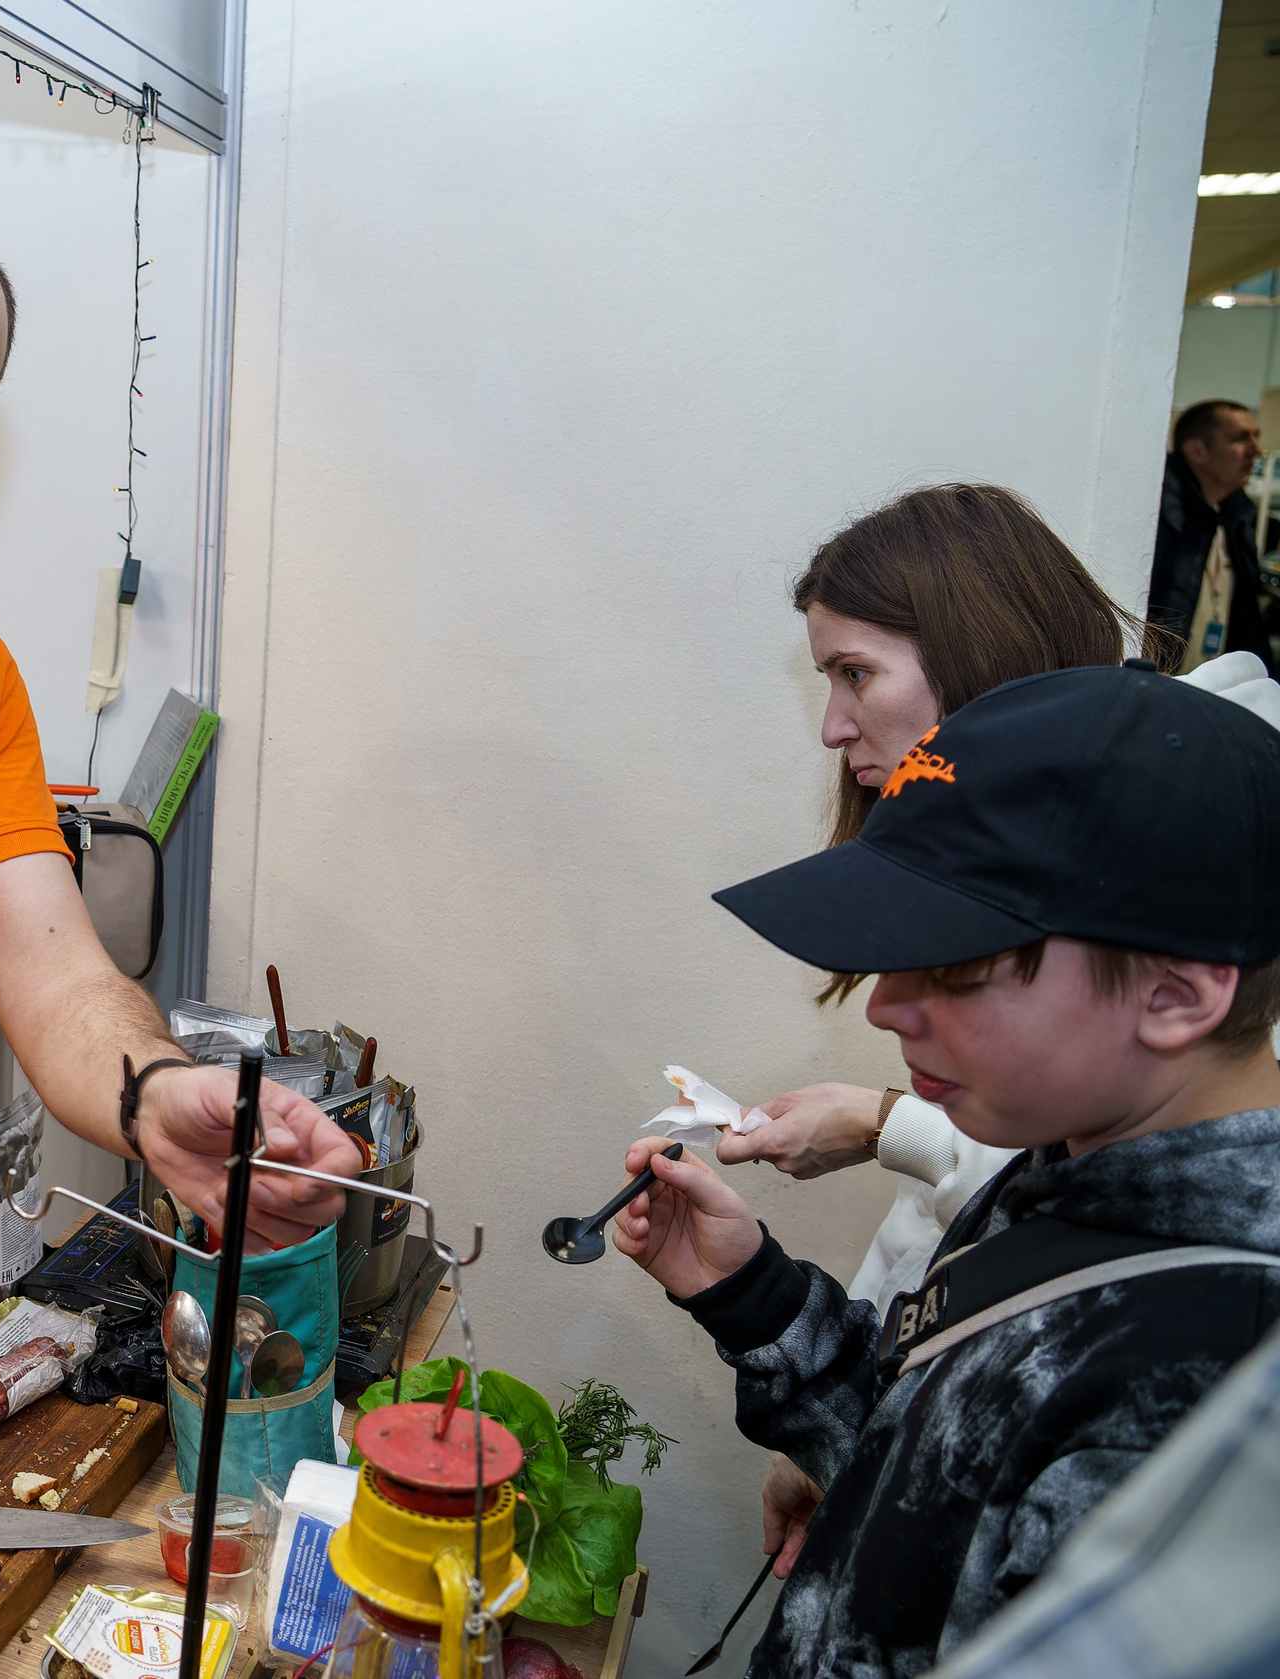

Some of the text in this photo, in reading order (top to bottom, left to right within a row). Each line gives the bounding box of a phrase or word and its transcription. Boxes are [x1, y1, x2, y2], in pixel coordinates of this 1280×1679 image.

[157, 754, 196, 824] ИСЧЕЗАЮЩИЙ
[297, 1543, 310, 1578] тиснением,
[307, 1558, 320, 1588] бытового
[276, 1525, 309, 1639] Салфетки бумажные торговой марки
[300, 1566, 326, 1650] санитарно-гигиенического
[303, 1588, 314, 1610] бумаги
[129, 1624, 140, 1650] САЦИВИ
[156, 1630, 171, 1663] Удобная
[294, 1618, 306, 1647] Изделия
[148, 1645, 158, 1662] еда
